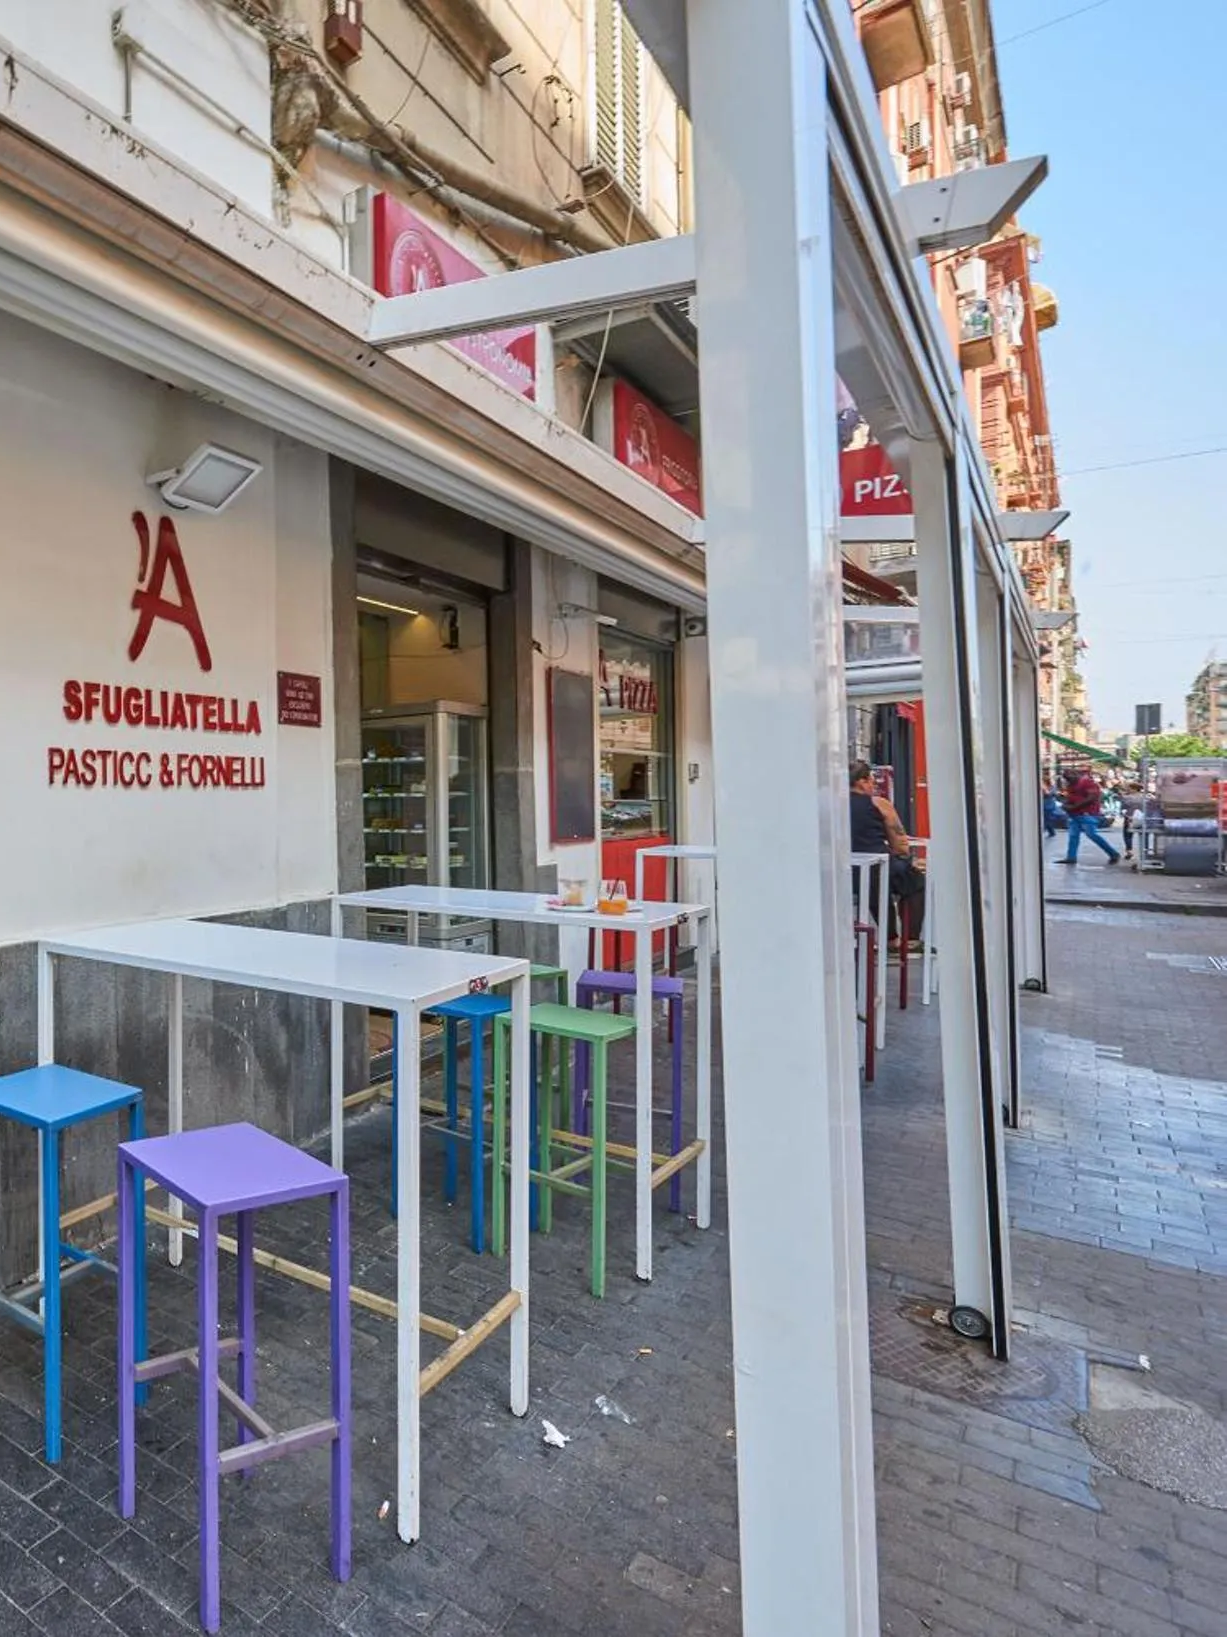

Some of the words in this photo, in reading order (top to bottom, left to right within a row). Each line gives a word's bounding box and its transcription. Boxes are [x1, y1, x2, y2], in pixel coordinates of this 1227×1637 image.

[854, 473, 909, 503] PIZ
[62, 680, 262, 735] SFUGLIATELLA
[47, 746, 152, 788] PASTICC
[158, 754, 174, 787] &
[176, 751, 265, 788] FORNELLI
